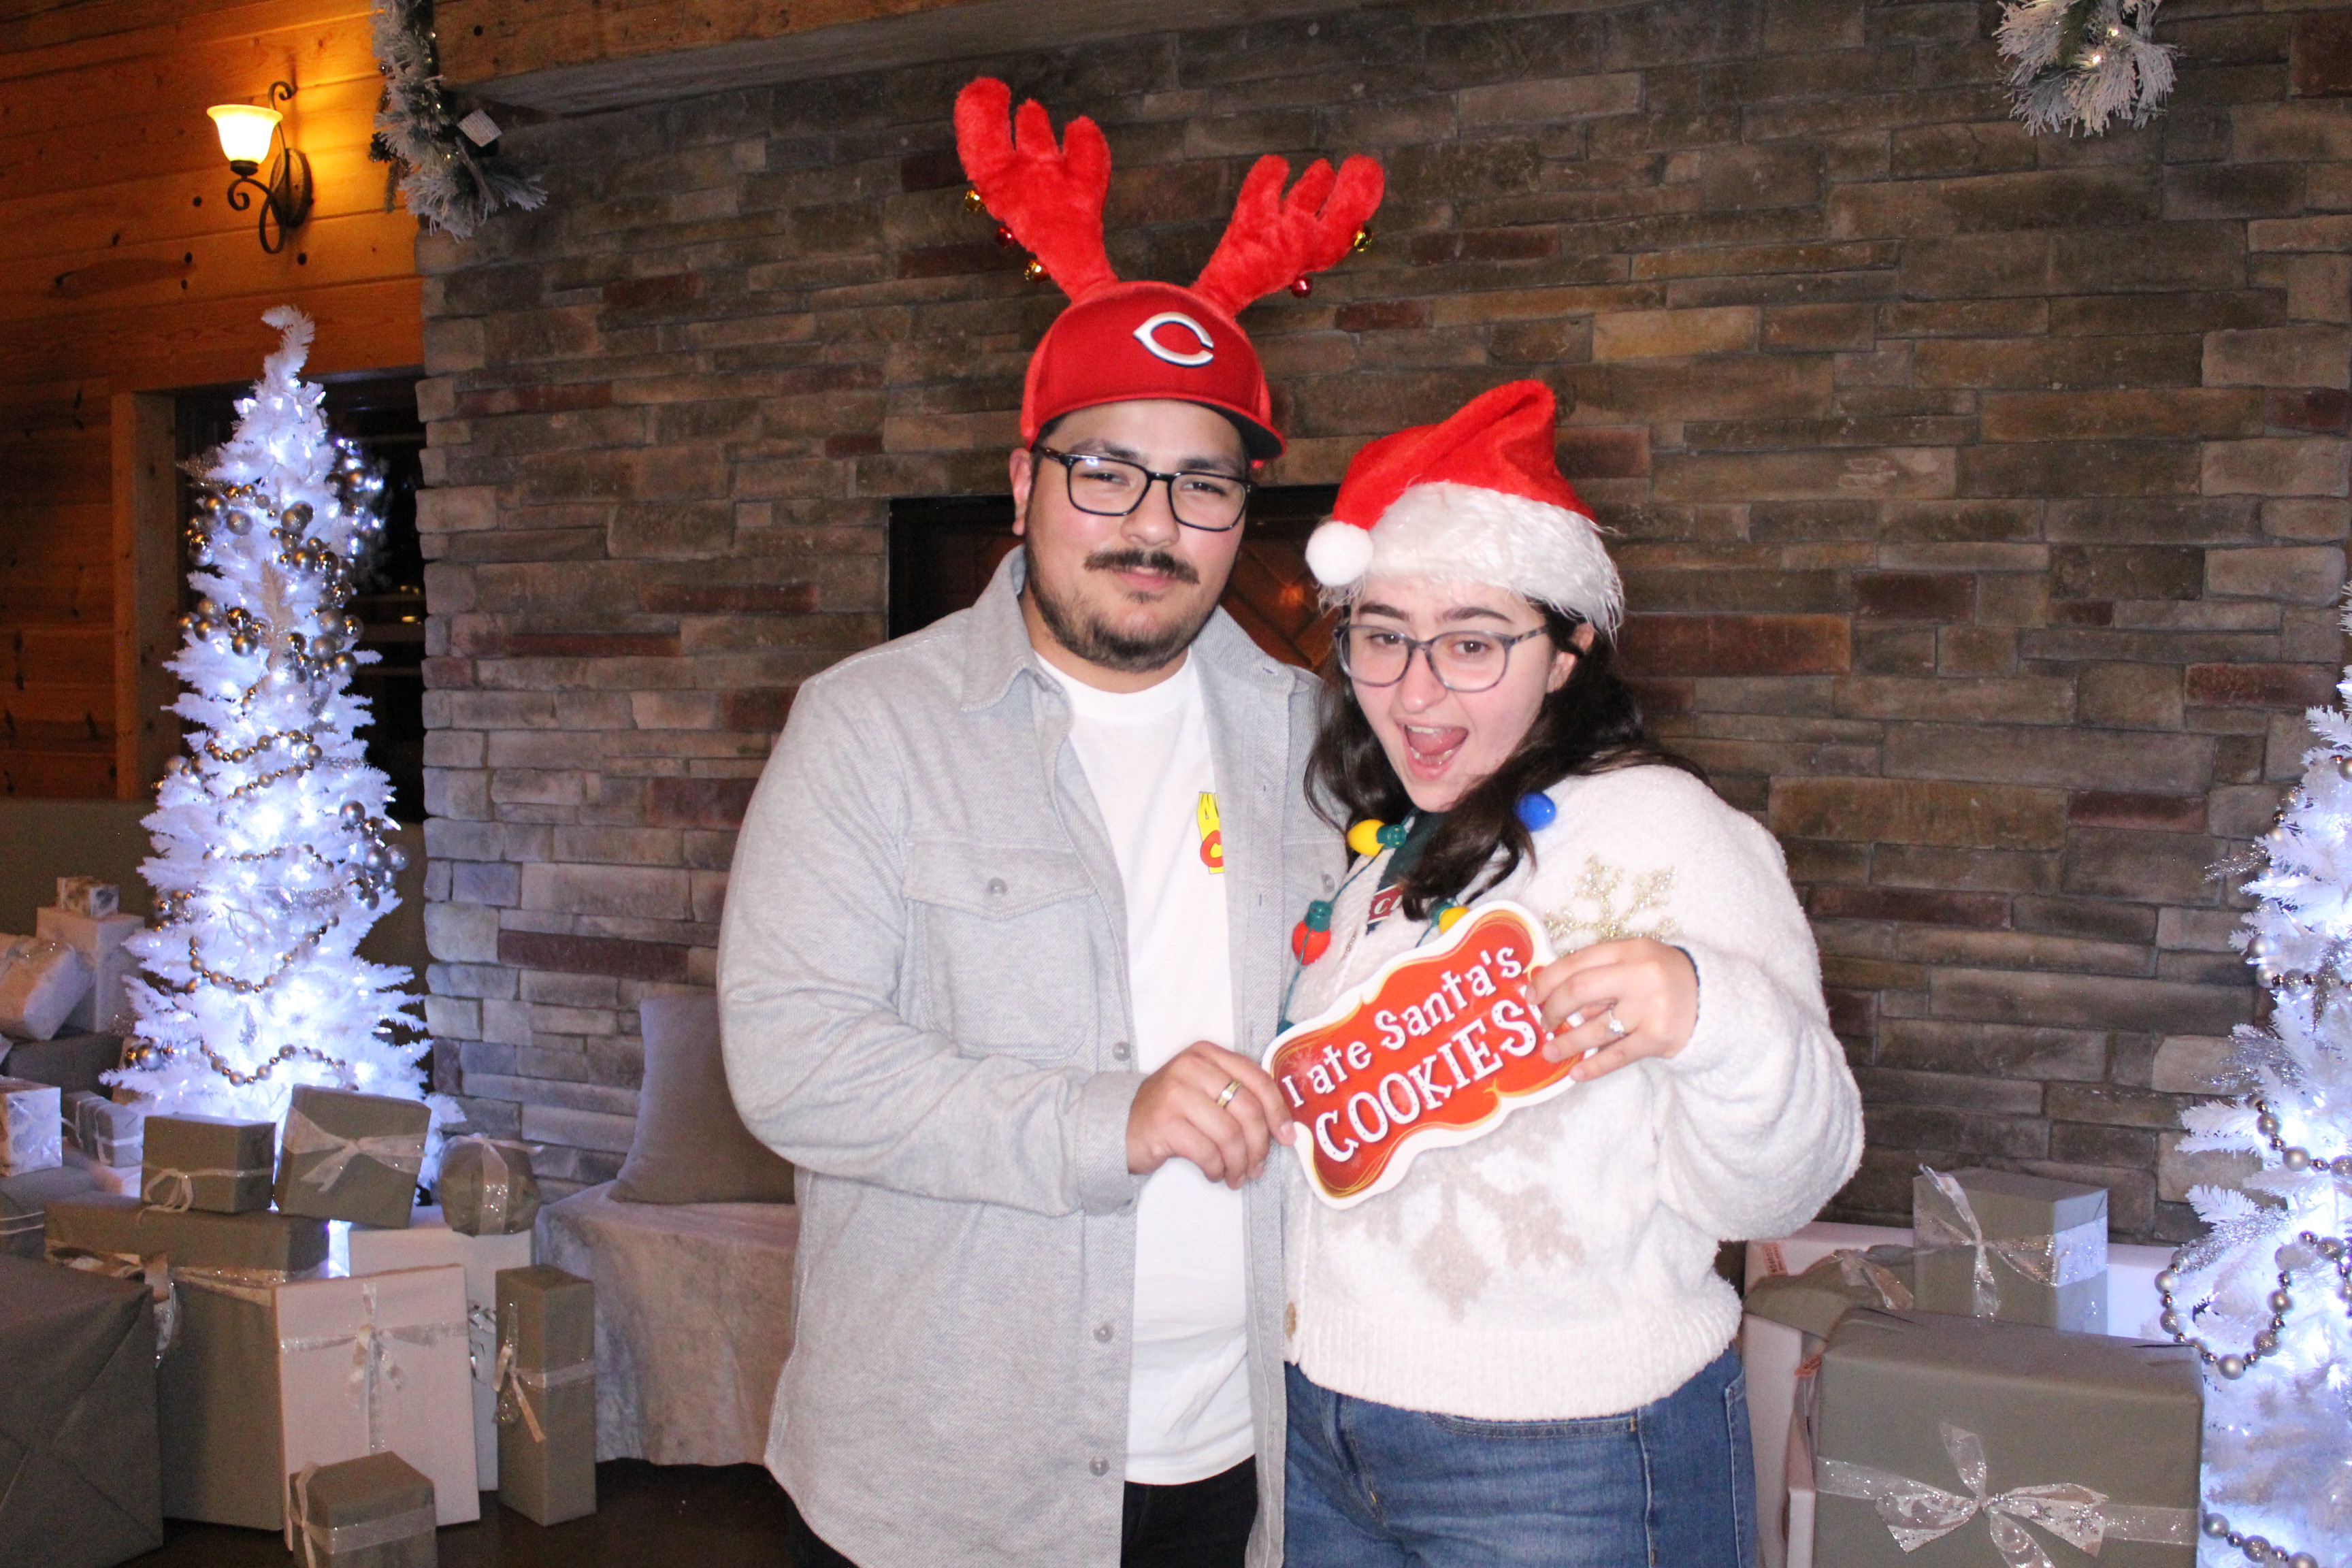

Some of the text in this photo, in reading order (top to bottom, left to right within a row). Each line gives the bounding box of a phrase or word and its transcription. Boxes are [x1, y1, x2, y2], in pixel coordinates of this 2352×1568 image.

[1133, 311, 1214, 368] C
[1282, 946, 1522, 1108] I ate Santa's
